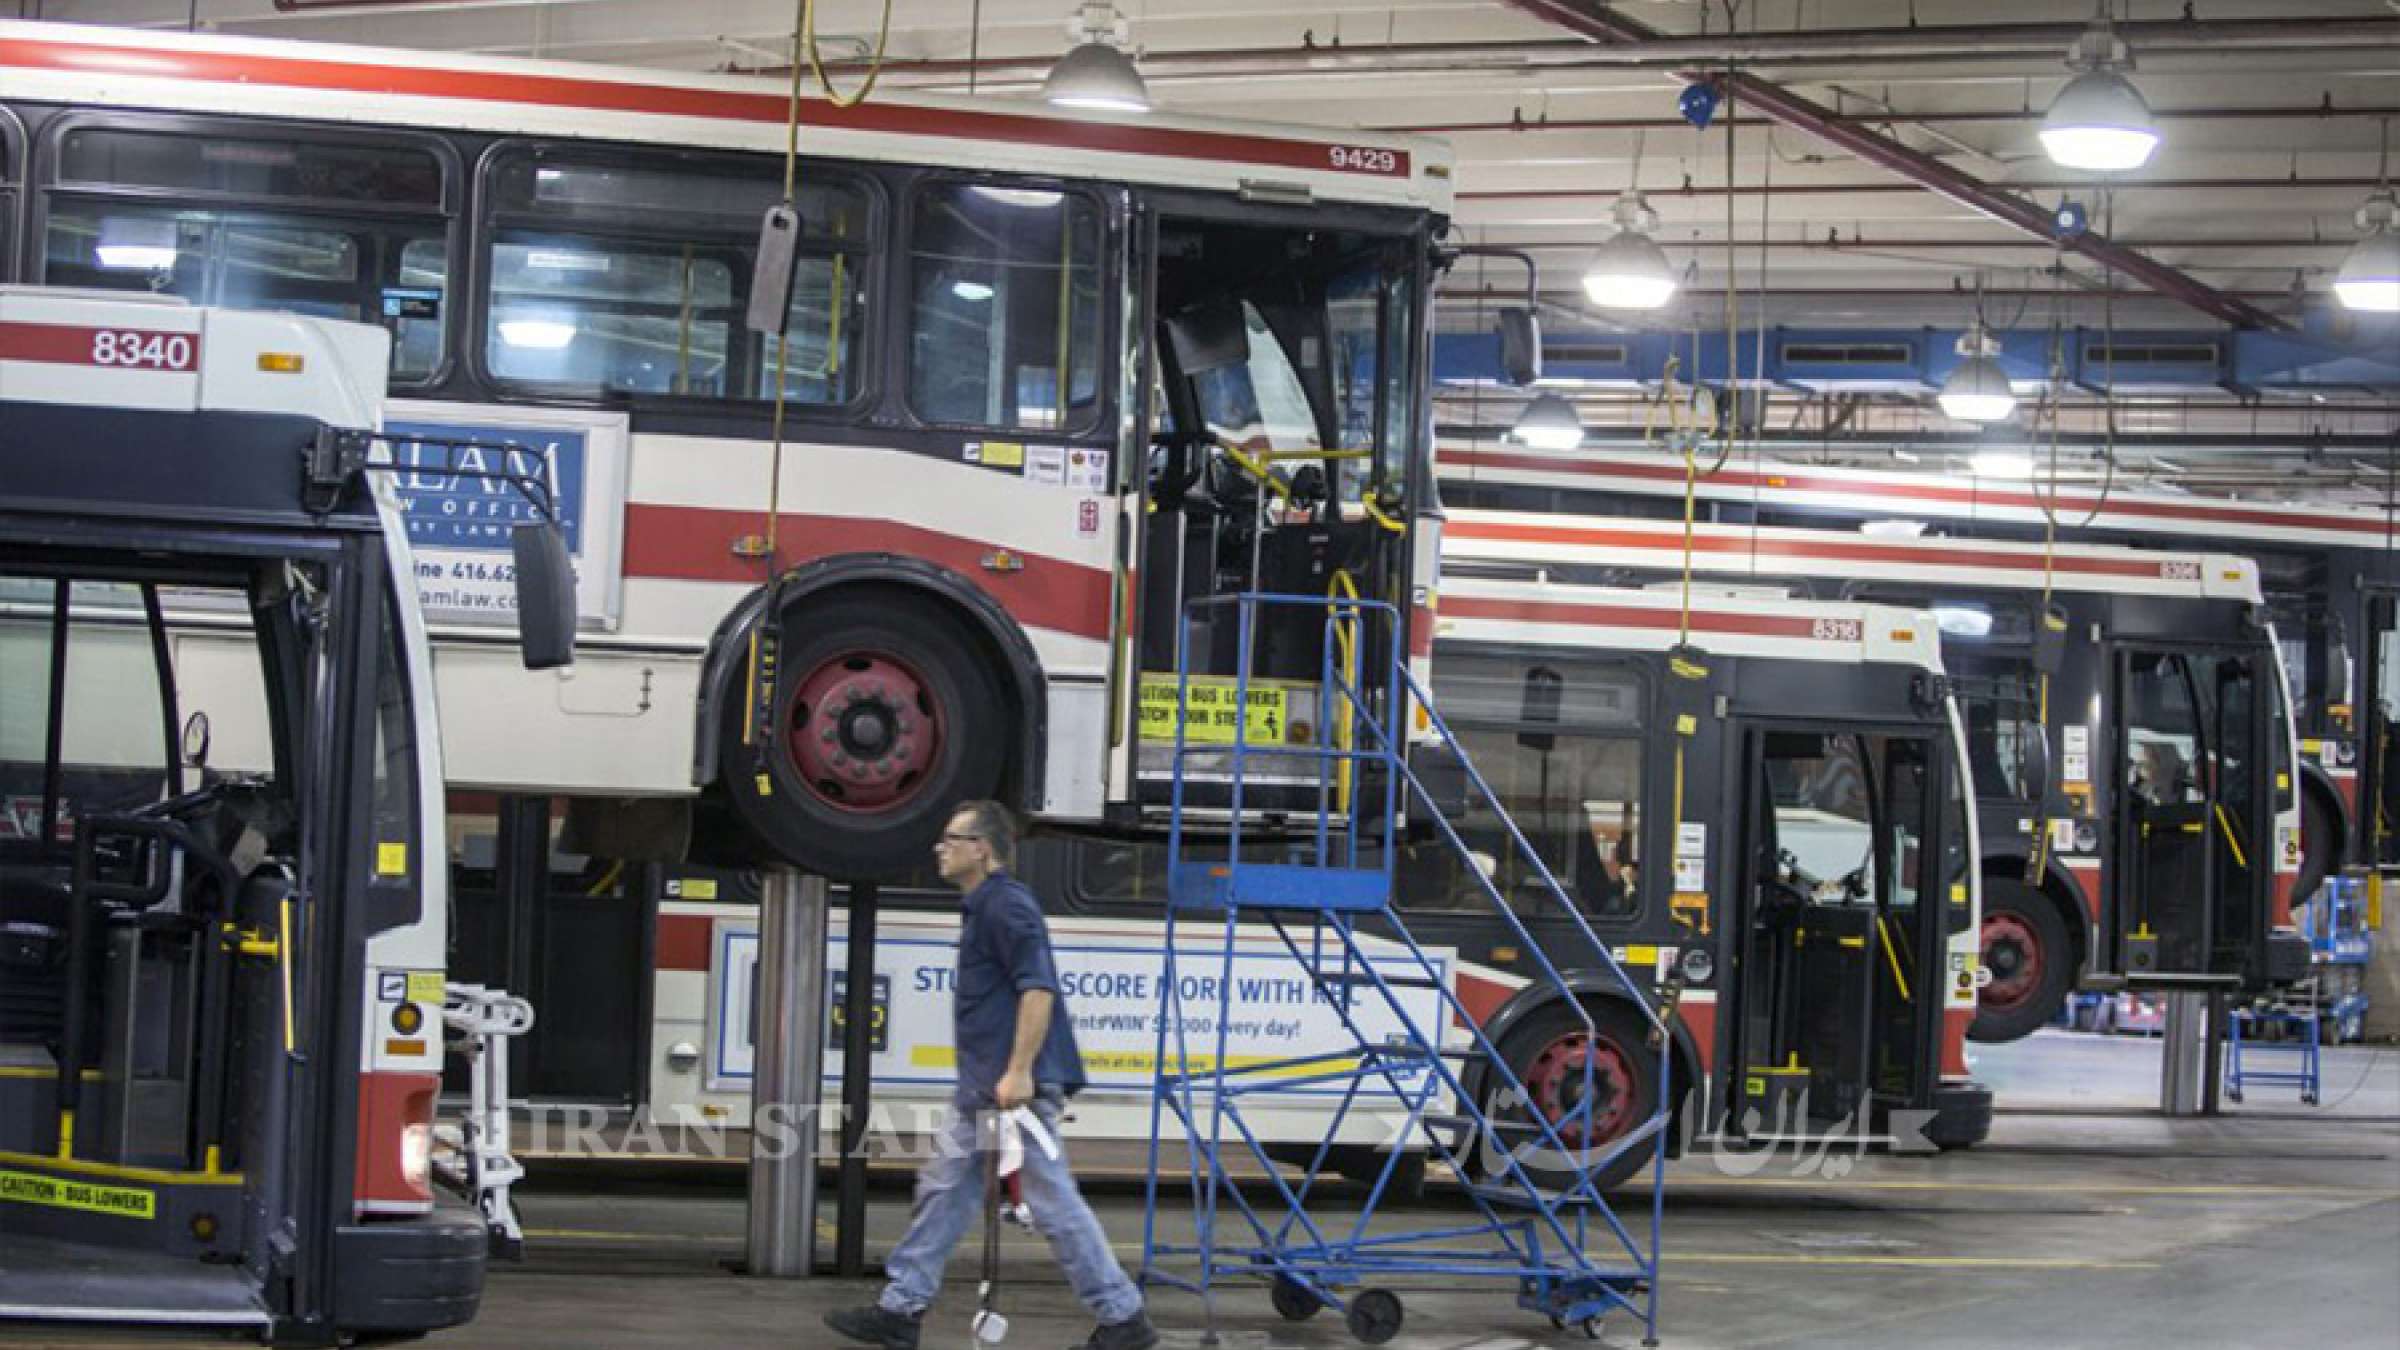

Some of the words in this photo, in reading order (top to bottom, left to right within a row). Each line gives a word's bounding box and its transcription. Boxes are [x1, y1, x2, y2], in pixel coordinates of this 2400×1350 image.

[1328, 146, 1396, 172] 9429
[94, 331, 190, 368] 8340
[1060, 971, 1147, 999] SCORE
[1238, 978, 1305, 1004] WITH
